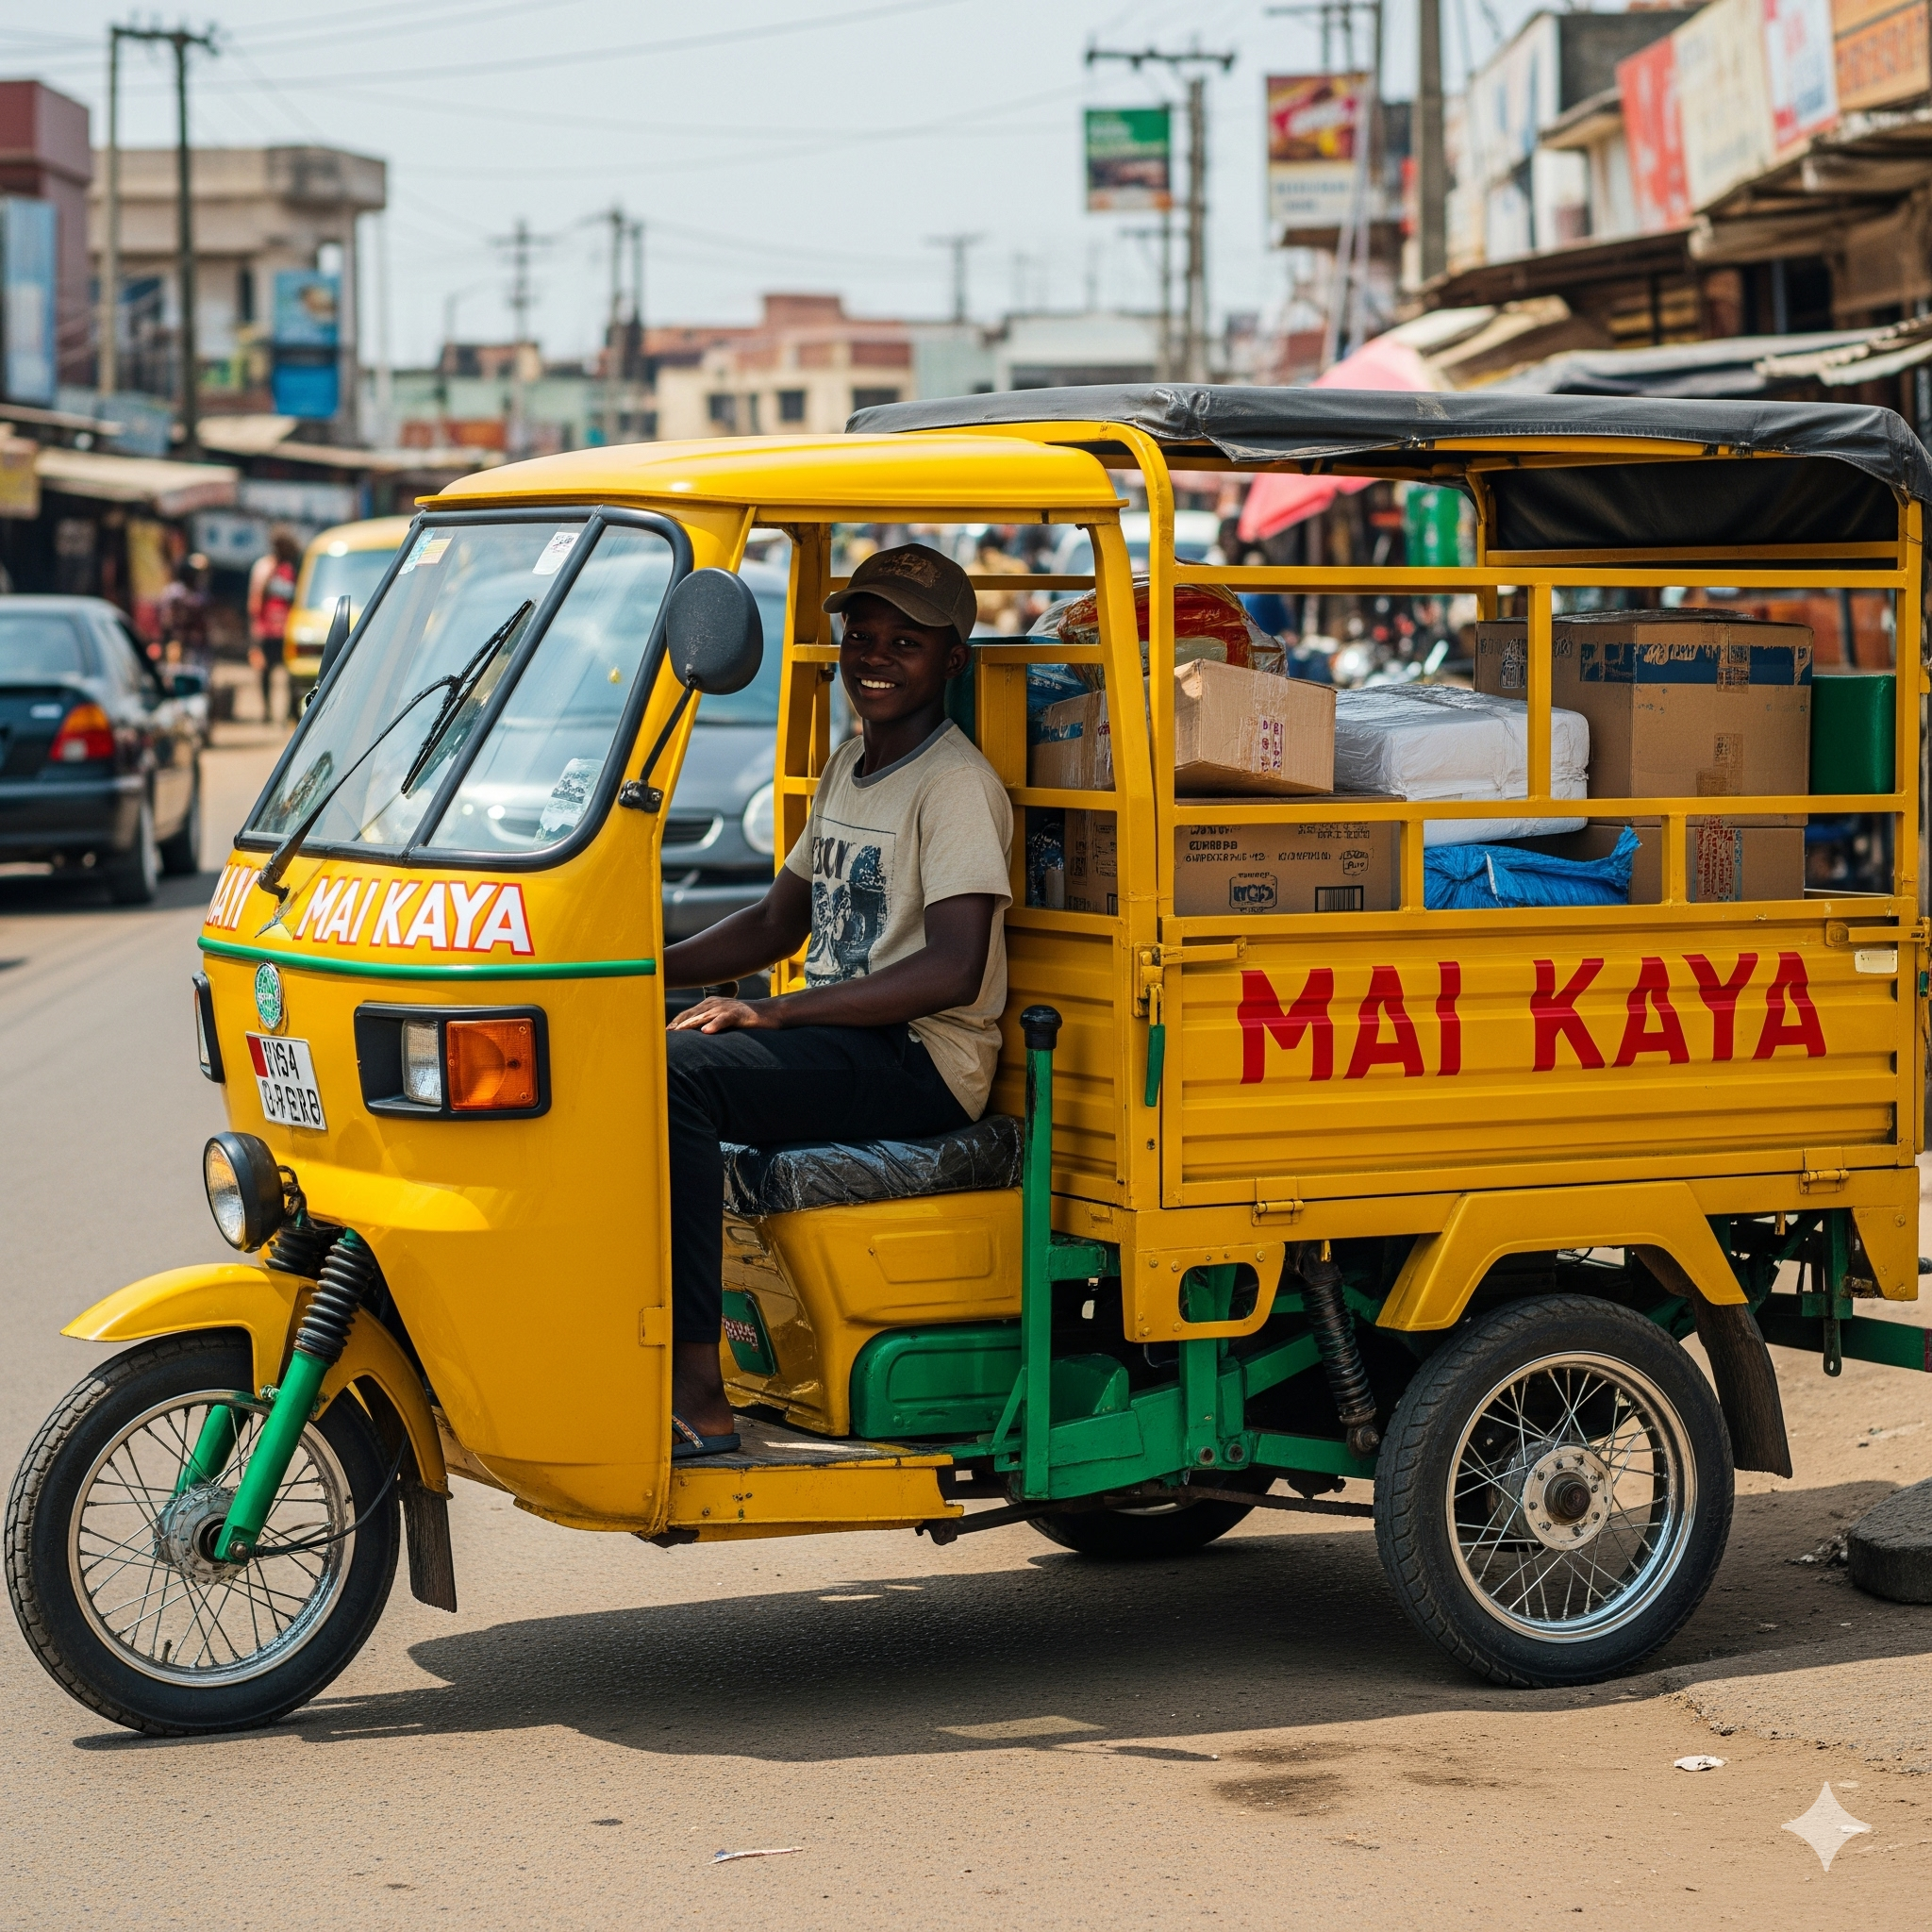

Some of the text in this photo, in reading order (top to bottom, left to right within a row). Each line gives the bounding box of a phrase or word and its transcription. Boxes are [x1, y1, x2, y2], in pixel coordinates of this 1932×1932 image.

[293, 875, 536, 957] MAI KAYA
[1238, 951, 1828, 1085] MAI KAYA
